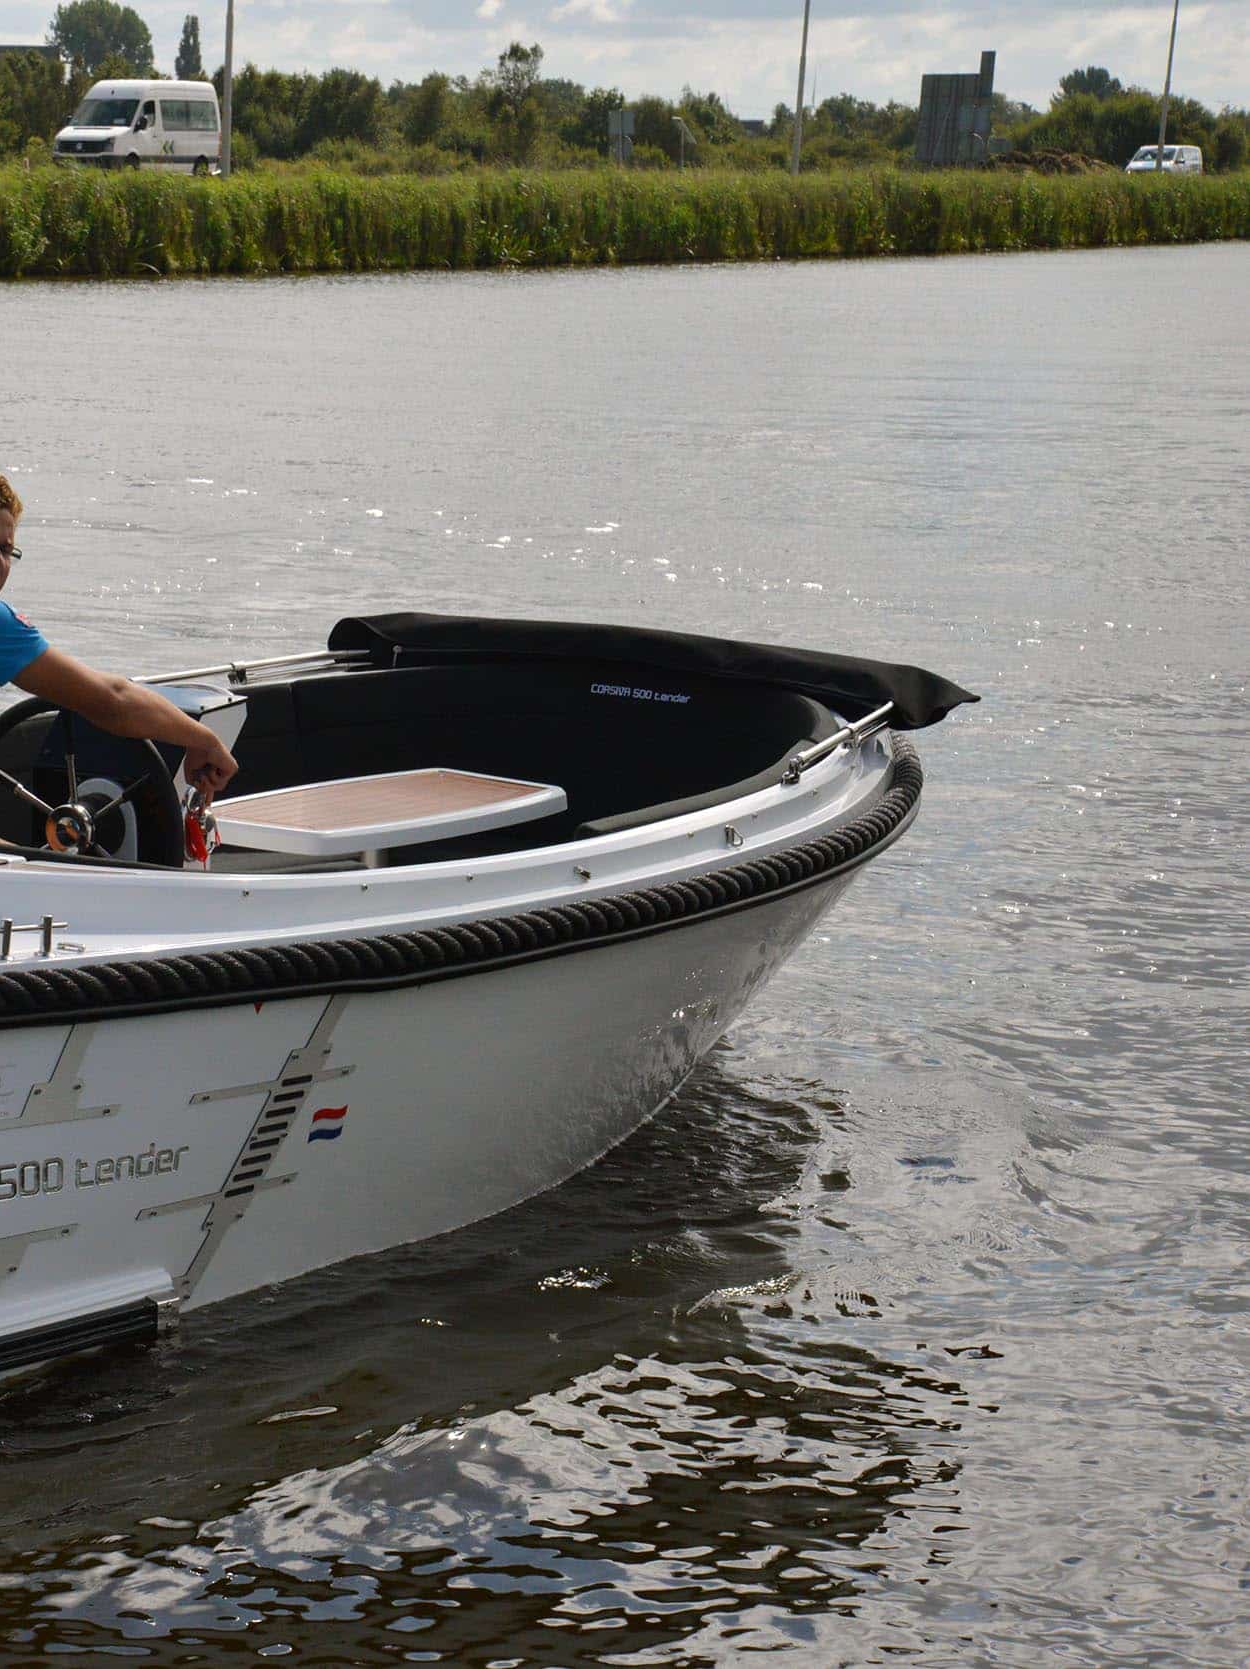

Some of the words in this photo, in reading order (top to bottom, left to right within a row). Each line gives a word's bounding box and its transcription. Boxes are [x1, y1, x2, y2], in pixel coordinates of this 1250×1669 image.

[590, 684, 630, 697] CORSIVA
[632, 689, 652, 700] 500
[654, 693, 690, 703] tender
[75, 1142, 189, 1190] tender
